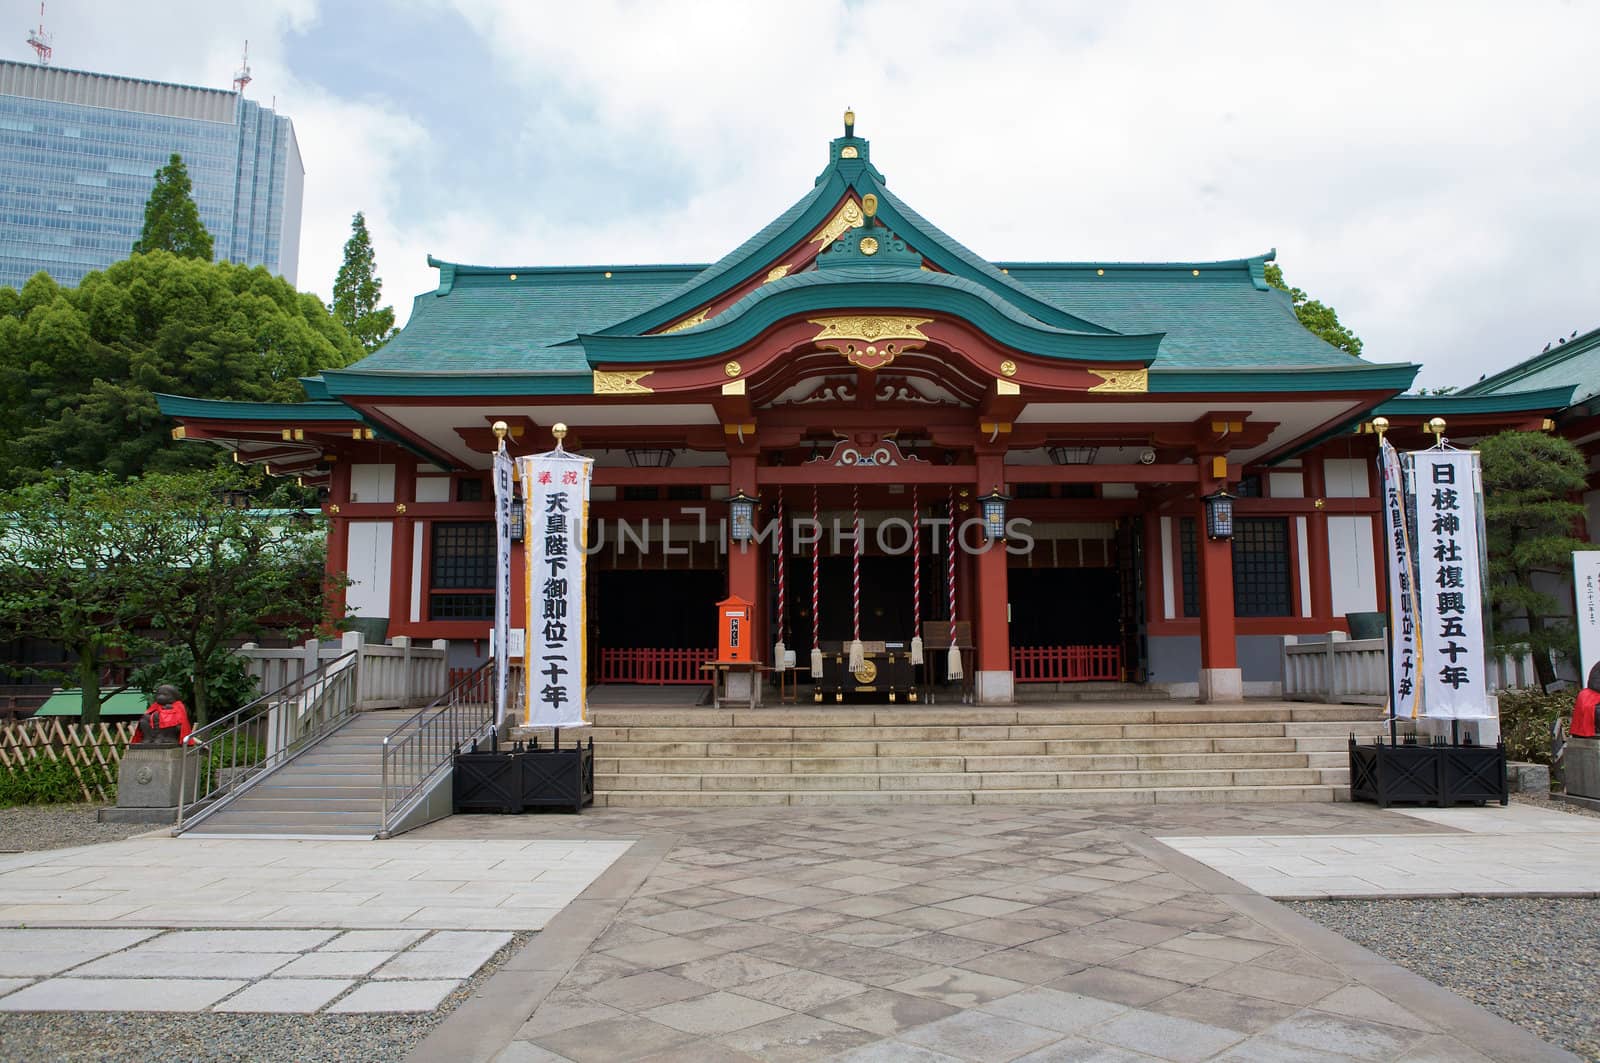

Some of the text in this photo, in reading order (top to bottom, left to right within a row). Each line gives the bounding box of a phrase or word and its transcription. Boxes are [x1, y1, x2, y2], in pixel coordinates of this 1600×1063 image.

[537, 470, 578, 485] 奉祝
[1431, 462, 1470, 691] 日枝神社復興五十年
[540, 492, 571, 710] 天皇陛下御即位二十年
